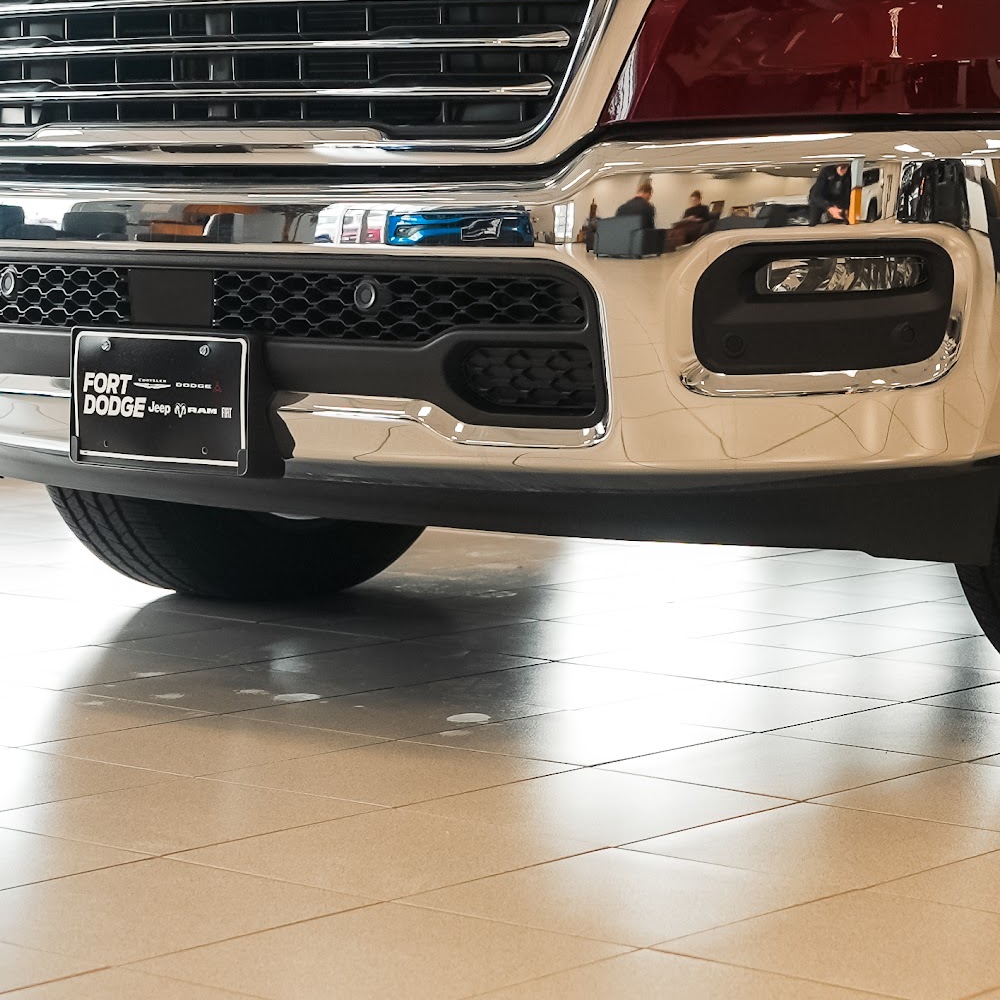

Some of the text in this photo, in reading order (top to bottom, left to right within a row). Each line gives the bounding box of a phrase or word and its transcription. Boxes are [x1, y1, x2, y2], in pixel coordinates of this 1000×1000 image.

[83, 372, 133, 395] FORT
[175, 382, 212, 390] DODGE
[83, 394, 147, 418] DODGE
[148, 401, 171, 415] Jeep
[187, 407, 218, 415] RAM
